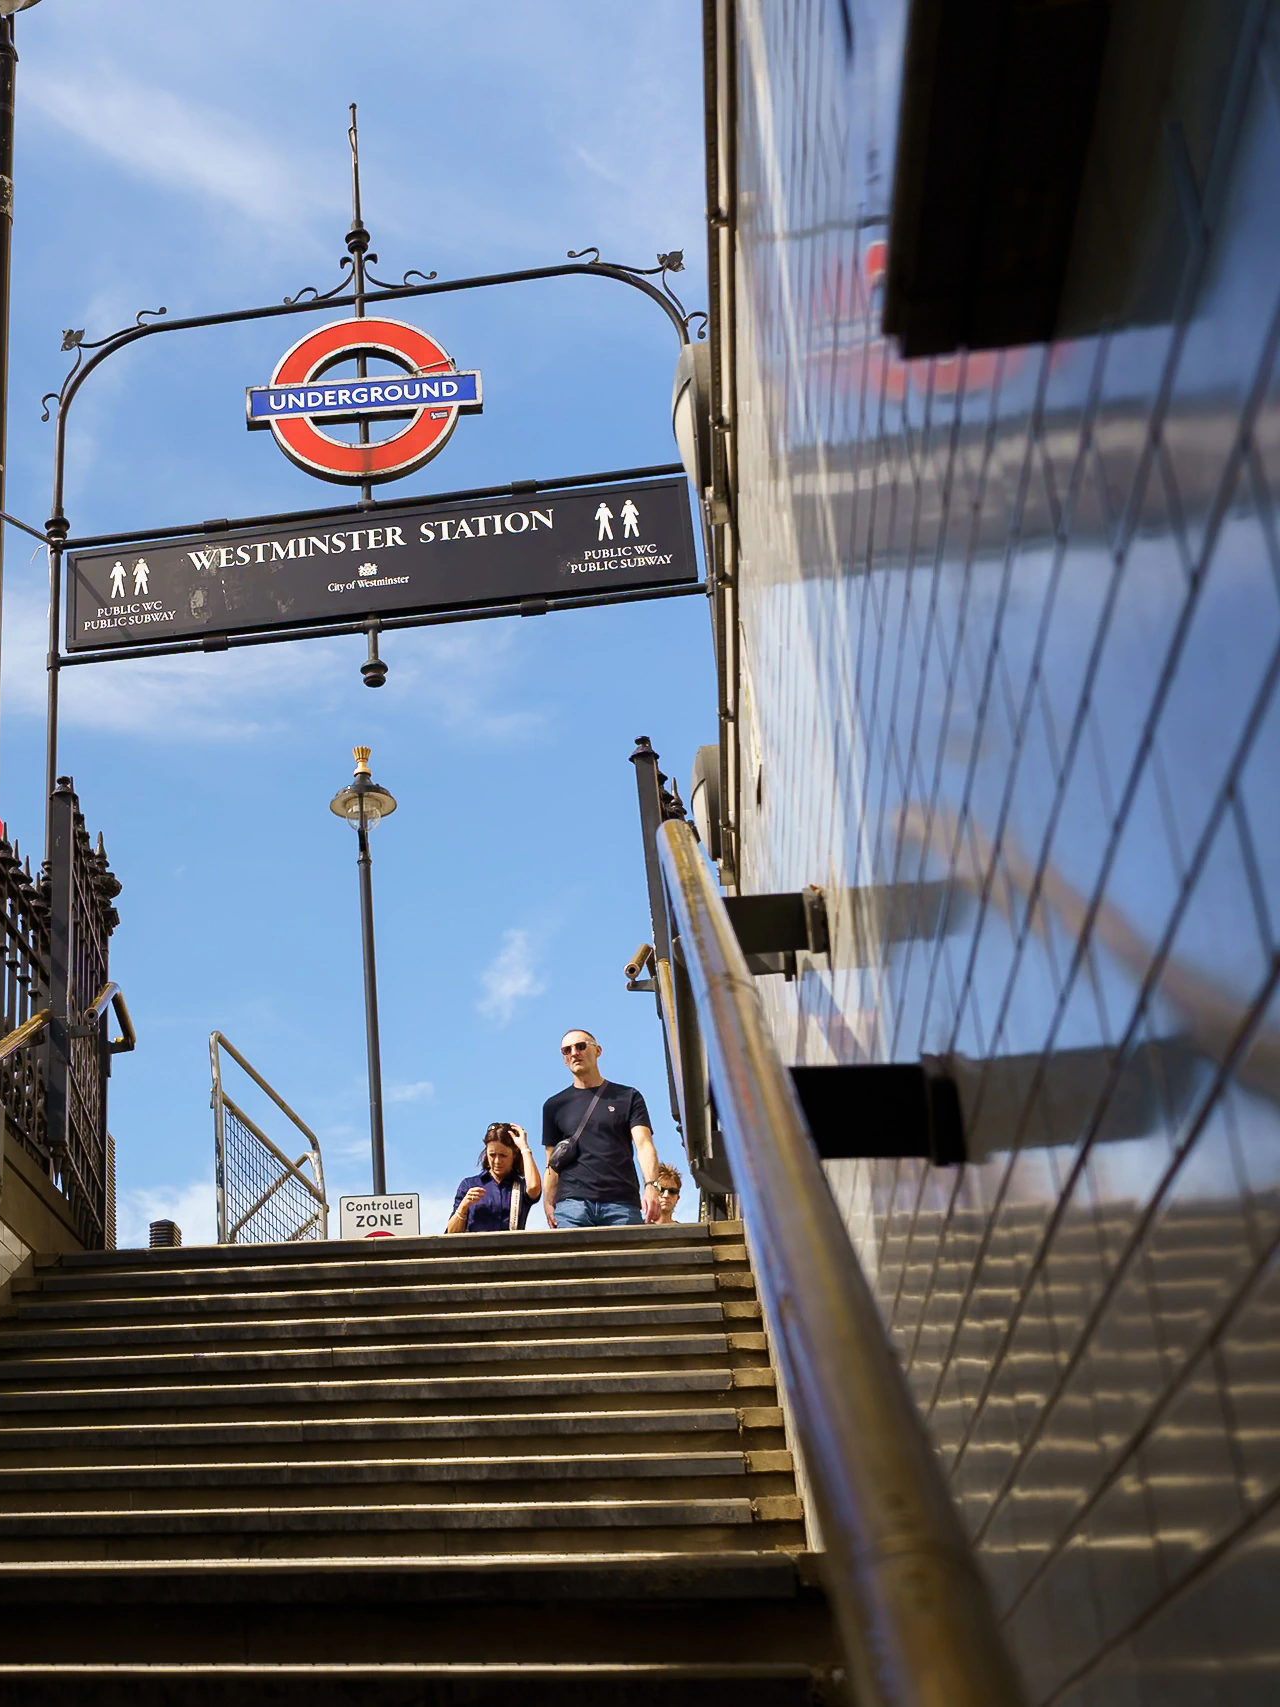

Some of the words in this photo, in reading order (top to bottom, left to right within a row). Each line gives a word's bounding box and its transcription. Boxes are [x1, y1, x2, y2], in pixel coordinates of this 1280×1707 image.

[270, 381, 459, 410] UNDERGROUND
[187, 526, 407, 571] WESTMINSTER
[420, 508, 554, 544] STATION
[584, 546, 633, 560] PUBLIC
[634, 543, 657, 555] WC
[571, 560, 618, 574] PUBLIC
[620, 554, 673, 569] SUBWAY
[327, 582, 345, 593] City
[345, 580, 357, 590] of
[357, 575, 410, 589] Westminster
[97, 603, 140, 617] PUBLIC
[142, 600, 163, 612] WC
[83, 616, 127, 631] PUBLIC
[128, 610, 177, 626] SUBWAY
[345, 1199, 413, 1212] Controlled
[355, 1213, 403, 1228] ZONE
